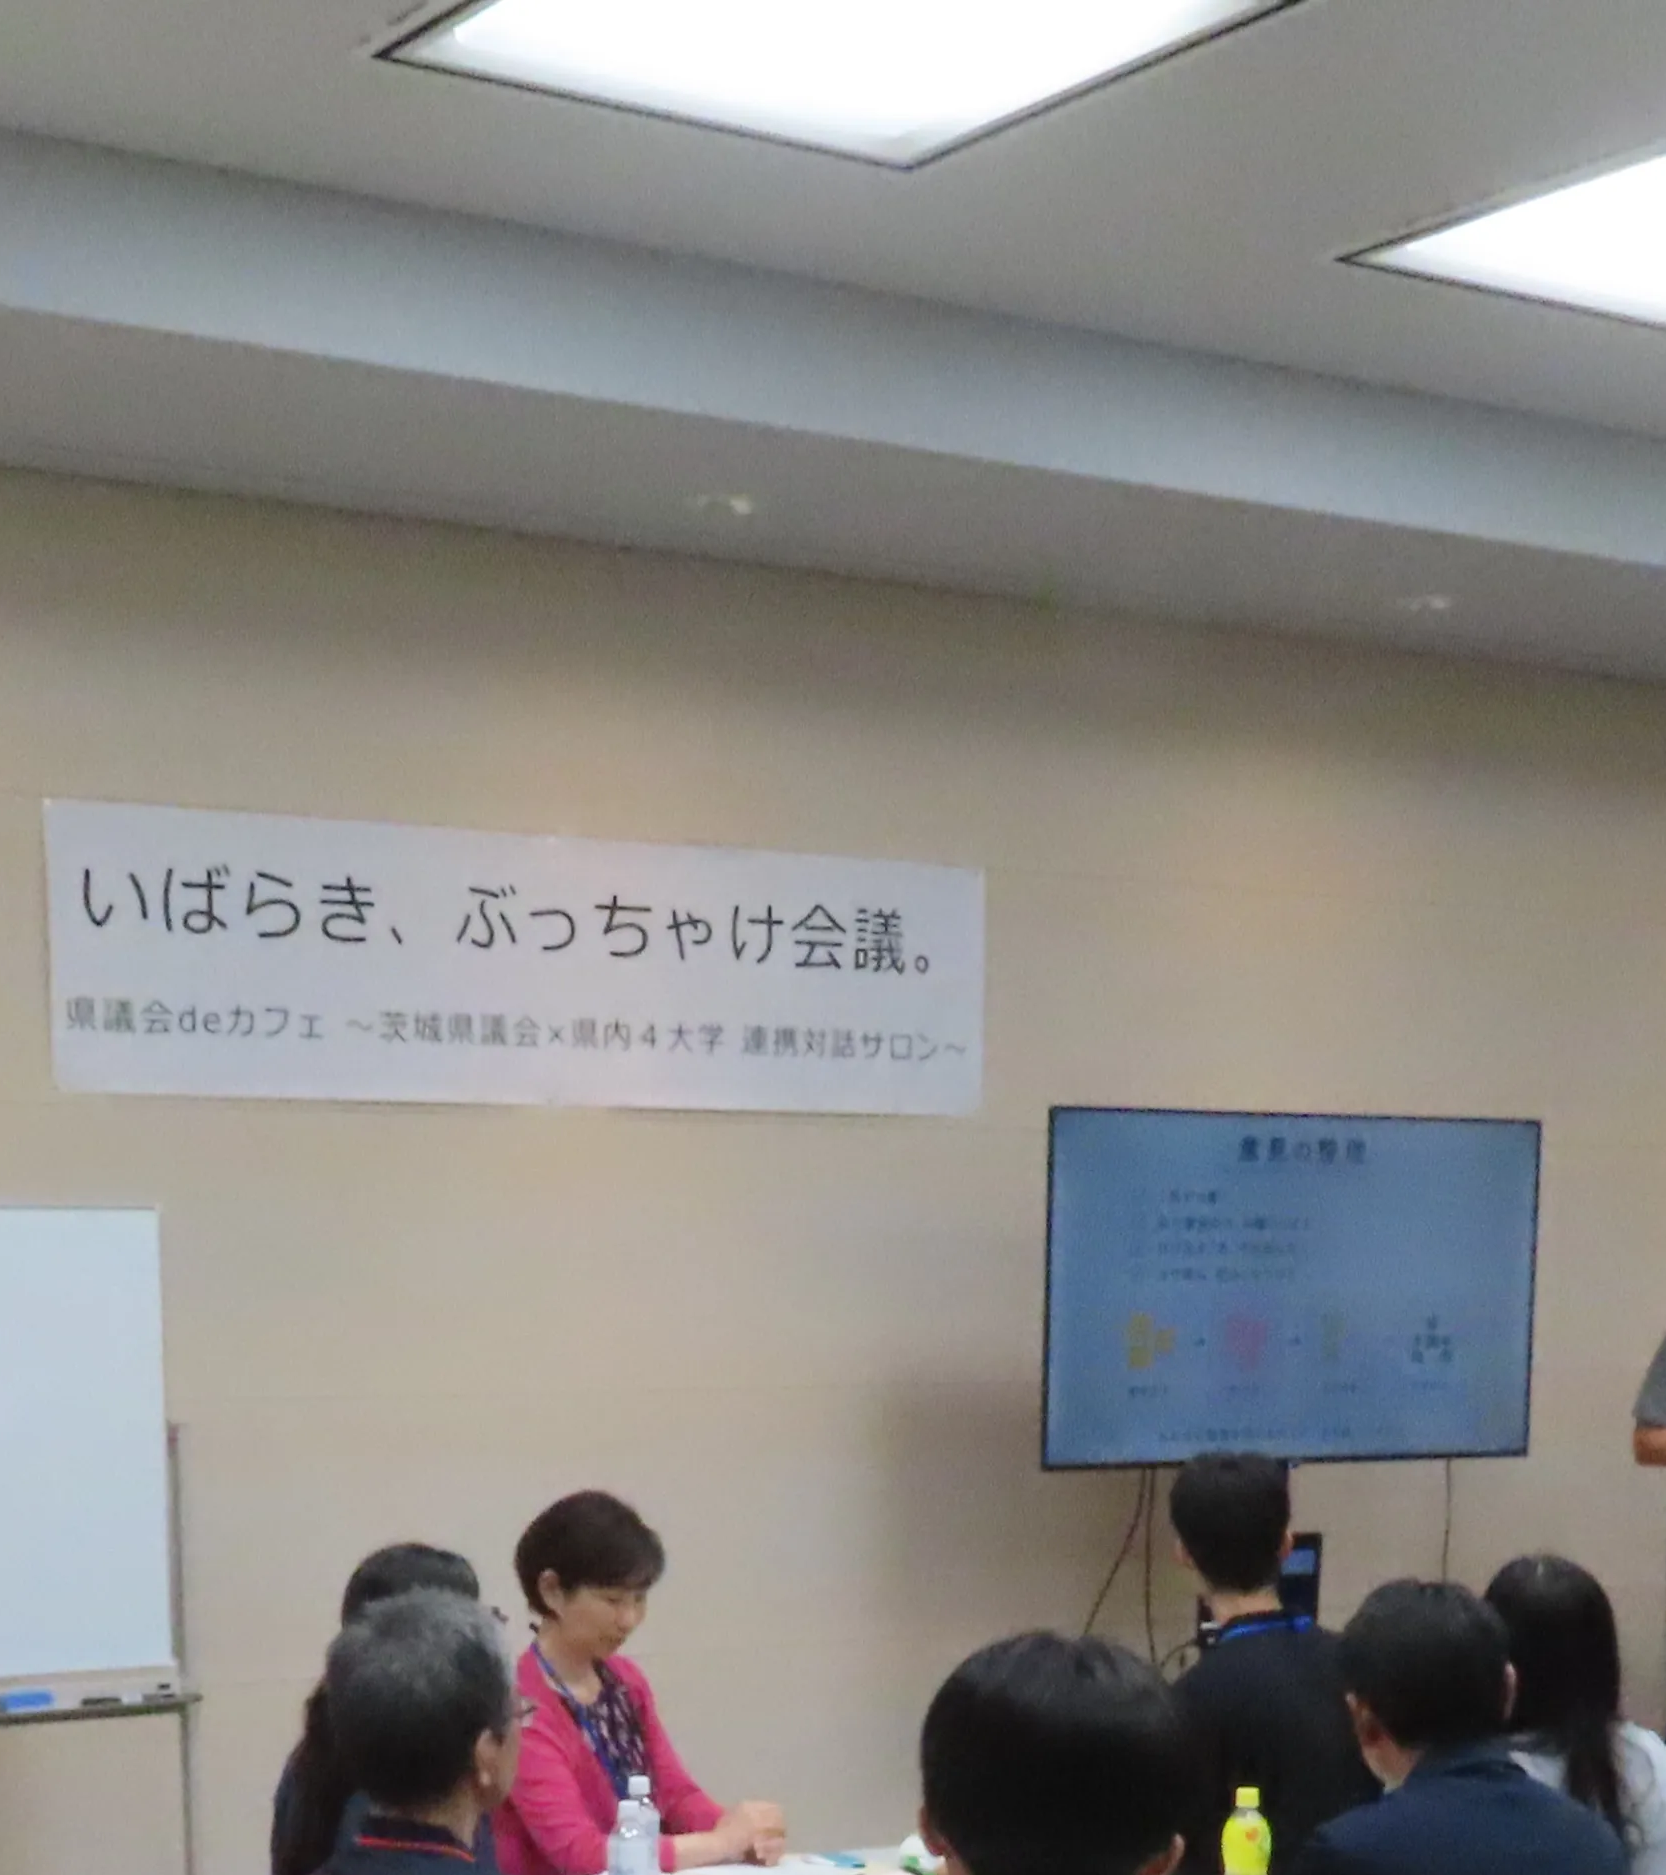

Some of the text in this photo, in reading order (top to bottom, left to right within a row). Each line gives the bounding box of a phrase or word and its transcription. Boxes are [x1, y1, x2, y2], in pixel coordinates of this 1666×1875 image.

[83, 867, 931, 976] いばらき、ぶっちゃけ会議。
